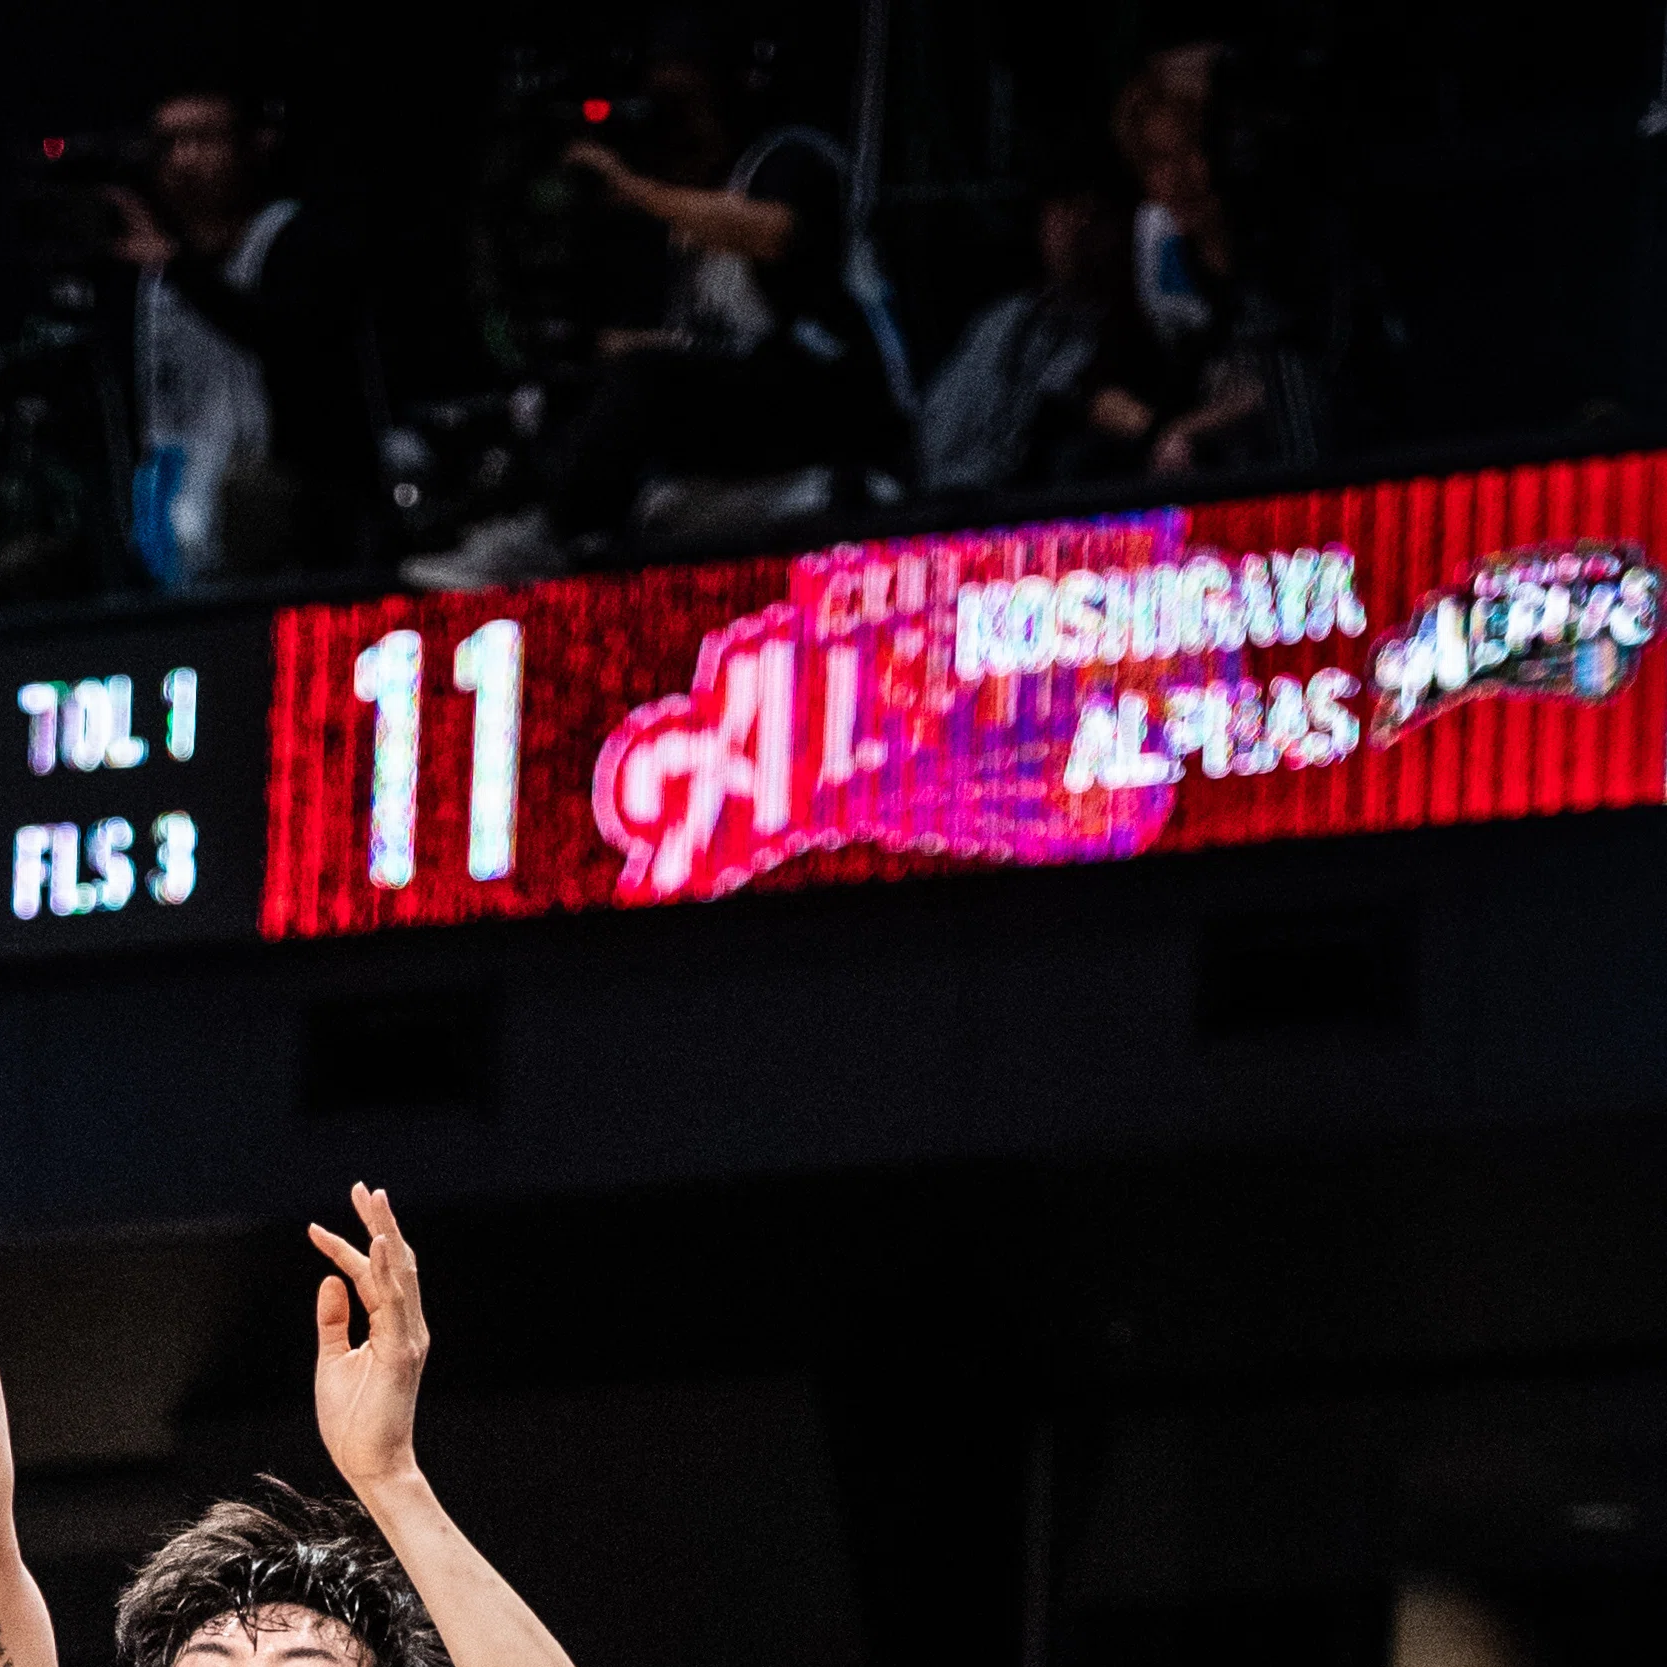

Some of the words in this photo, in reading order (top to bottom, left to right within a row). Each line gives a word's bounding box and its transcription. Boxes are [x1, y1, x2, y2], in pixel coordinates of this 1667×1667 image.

[162, 667, 197, 761] 1
[353, 617, 524, 891] 11
[12, 817, 134, 921] FLS
[146, 810, 197, 905] 3
